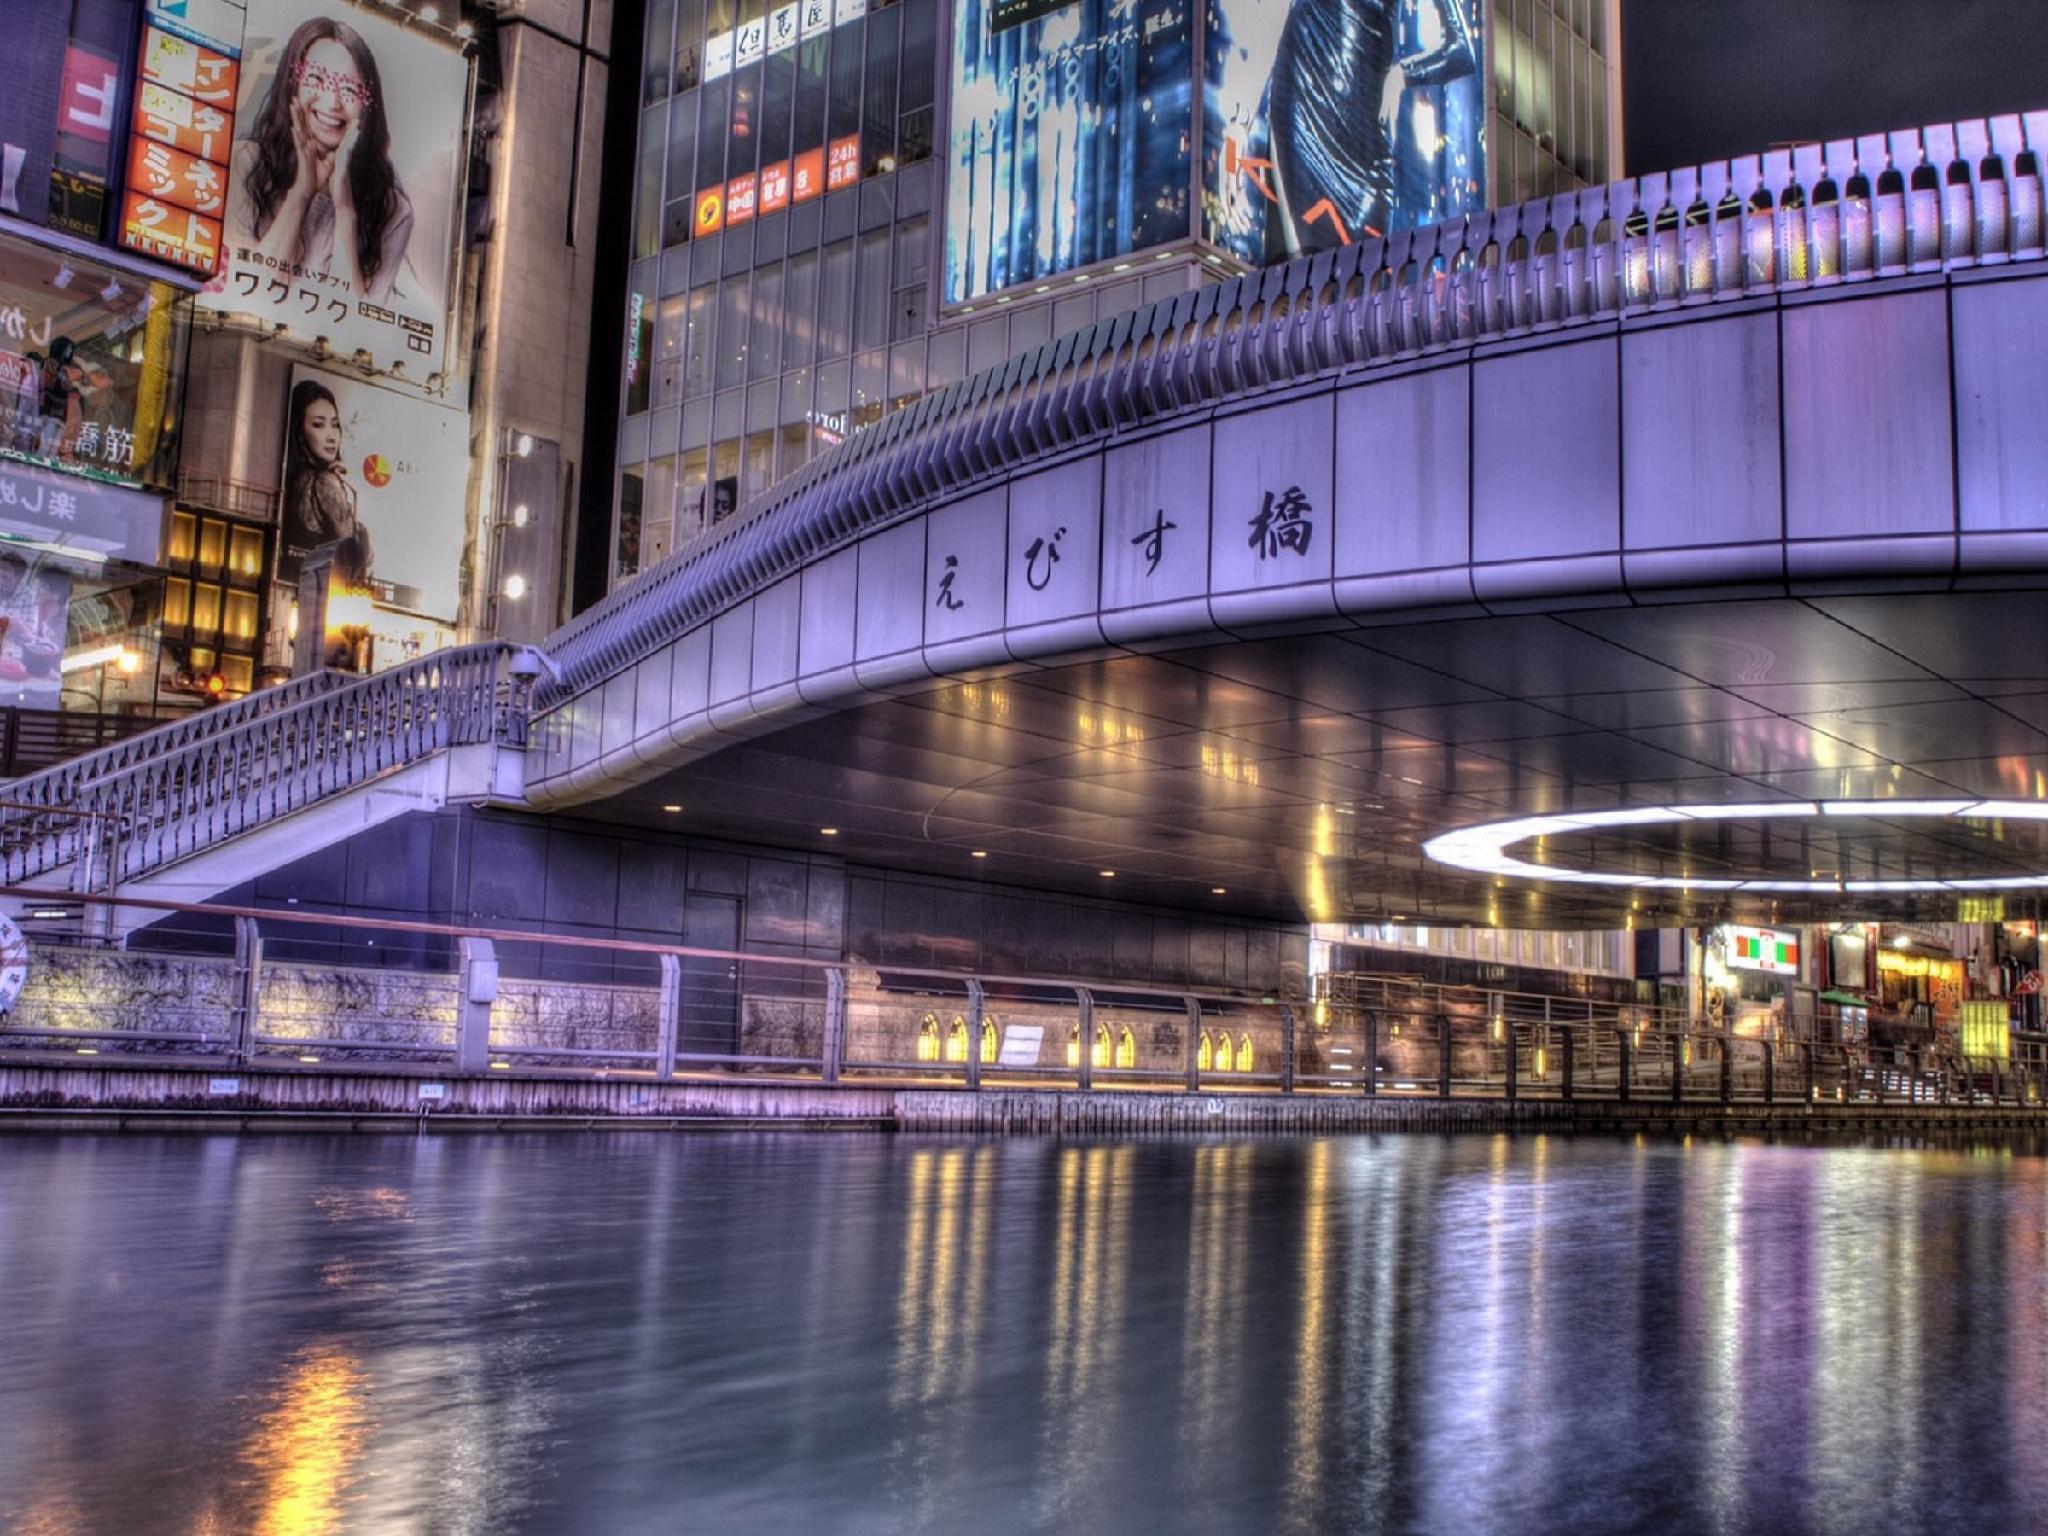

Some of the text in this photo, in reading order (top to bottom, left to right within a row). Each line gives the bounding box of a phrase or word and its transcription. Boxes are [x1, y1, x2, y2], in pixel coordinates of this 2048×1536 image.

[136, 112, 178, 226] コミック
[184, 58, 231, 246] インターネット
[235, 271, 349, 324] ワクワク
[935, 485, 1313, 611] えびす橋
